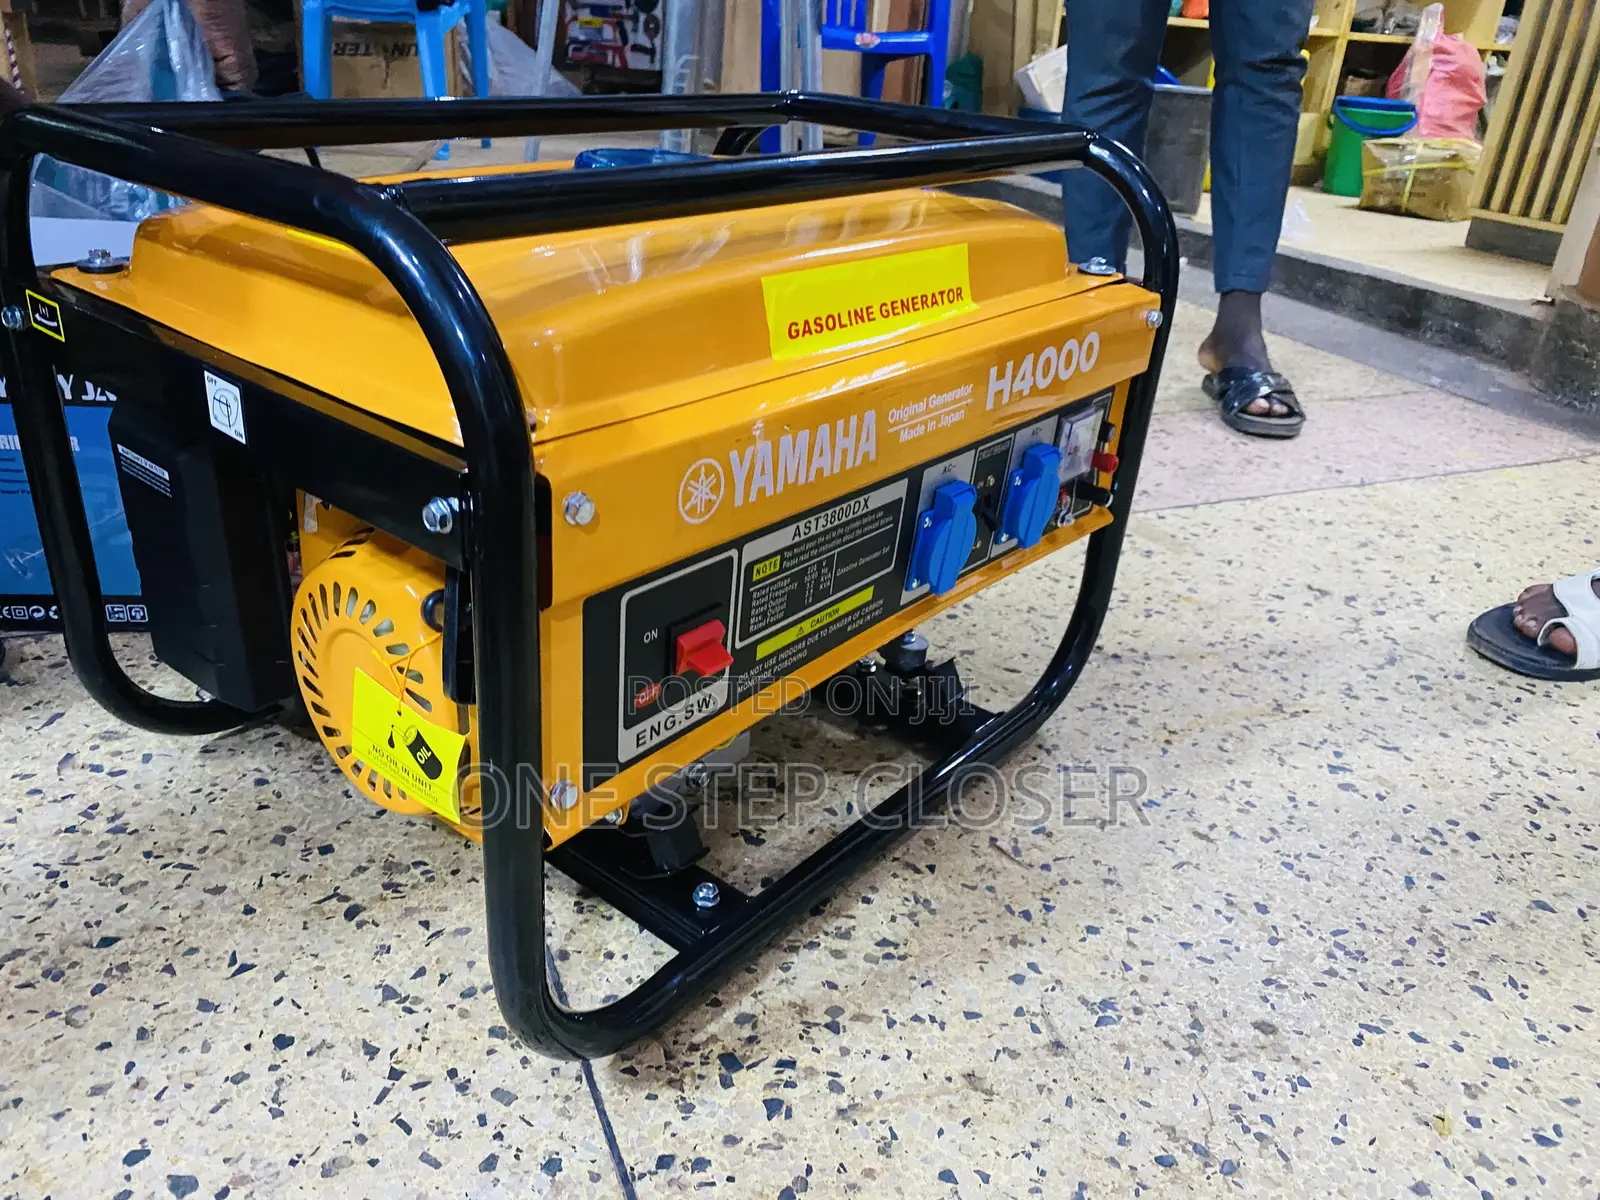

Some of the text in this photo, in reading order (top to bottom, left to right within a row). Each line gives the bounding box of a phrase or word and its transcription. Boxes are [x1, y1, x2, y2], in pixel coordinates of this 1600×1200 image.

[788, 287, 964, 340] GASOLINE GENERATOR
[985, 331, 1101, 411] H4000
[888, 383, 974, 424] Original Generator
[899, 408, 965, 443] Made in Japan
[729, 409, 876, 507] YAMAHA
[792, 496, 870, 541] AST3800DX
[755, 559, 779, 577] NOTE
[783, 558, 798, 569] Please
[752, 595, 769, 608] Rated
[769, 580, 798, 600] Frequency
[753, 585, 770, 599] Rated
[770, 577, 791, 592] voltage
[750, 604, 768, 617] Rated
[768, 593, 788, 610] Output
[767, 602, 787, 617] Output
[749, 620, 767, 633] Rated
[767, 611, 784, 625] Factor
[811, 608, 840, 629] CAUTION
[847, 606, 883, 633] MADE IN PRC
[643, 627, 659, 644] ON
[750, 663, 763, 677] NOT
[764, 655, 777, 669] USE
[778, 640, 806, 662] INDOORS
[807, 633, 820, 646] DUE
[820, 628, 828, 639] TO
[829, 614, 852, 634] DANGER
[773, 649, 808, 674] POISONING
[372, 744, 432, 791] NO OIL IN UNIT
[416, 745, 432, 764] OIL
